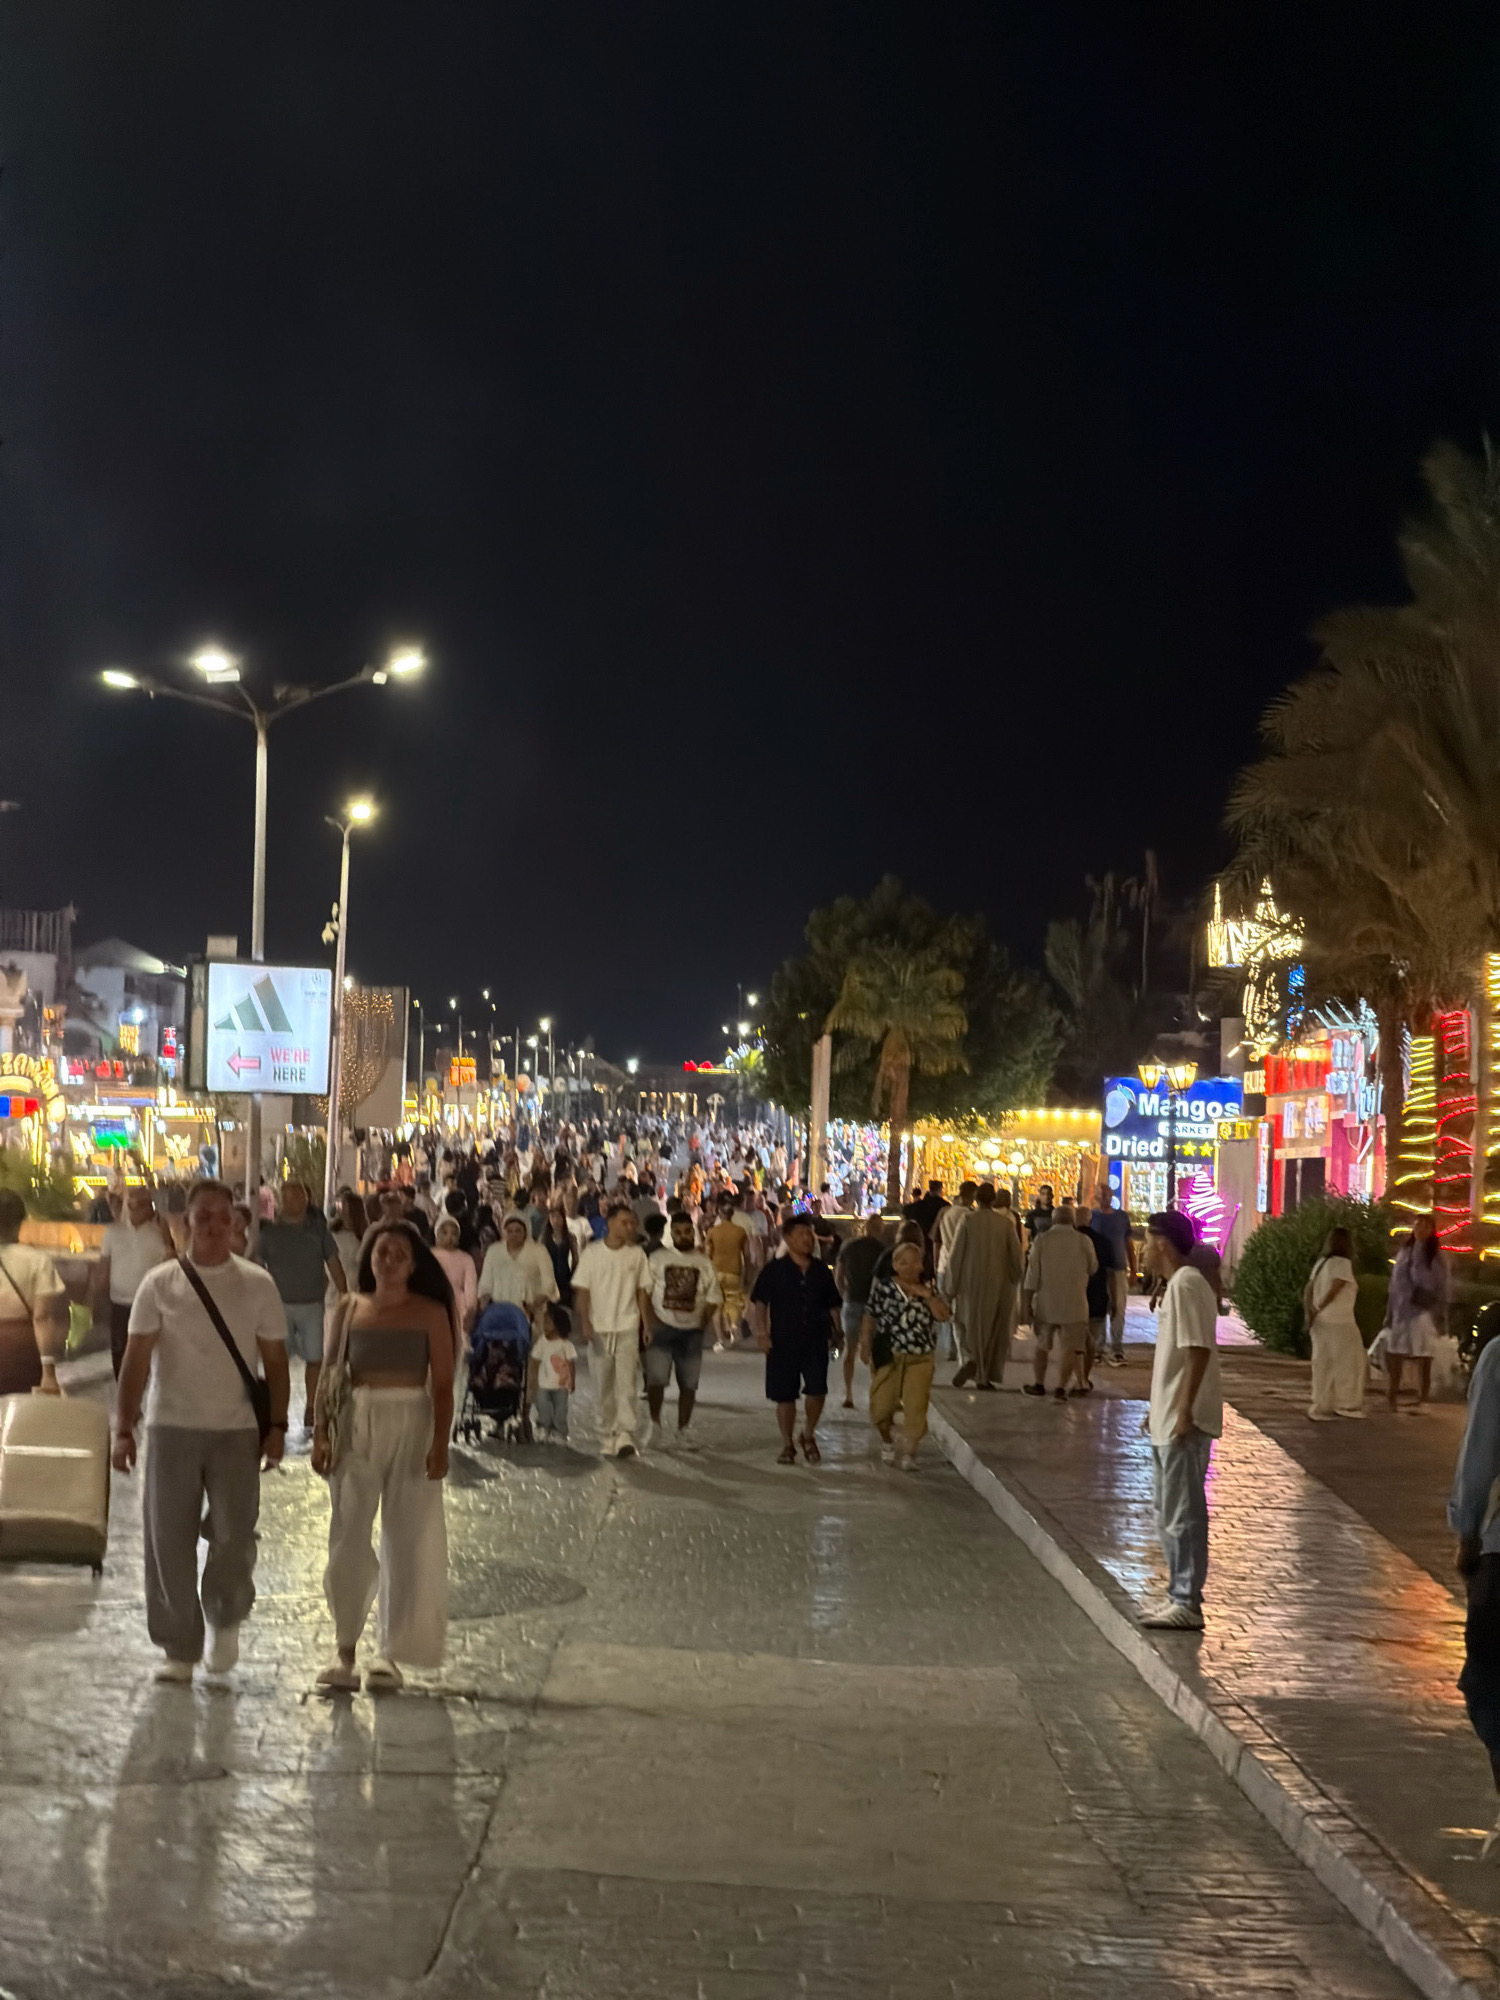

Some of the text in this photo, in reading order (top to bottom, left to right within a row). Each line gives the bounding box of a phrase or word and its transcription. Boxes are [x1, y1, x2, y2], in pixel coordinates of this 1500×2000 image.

[270, 1047, 310, 1063] WE'RE
[1138, 1093, 1240, 1122] Mangos
[1106, 1135, 1164, 1157] Dried
